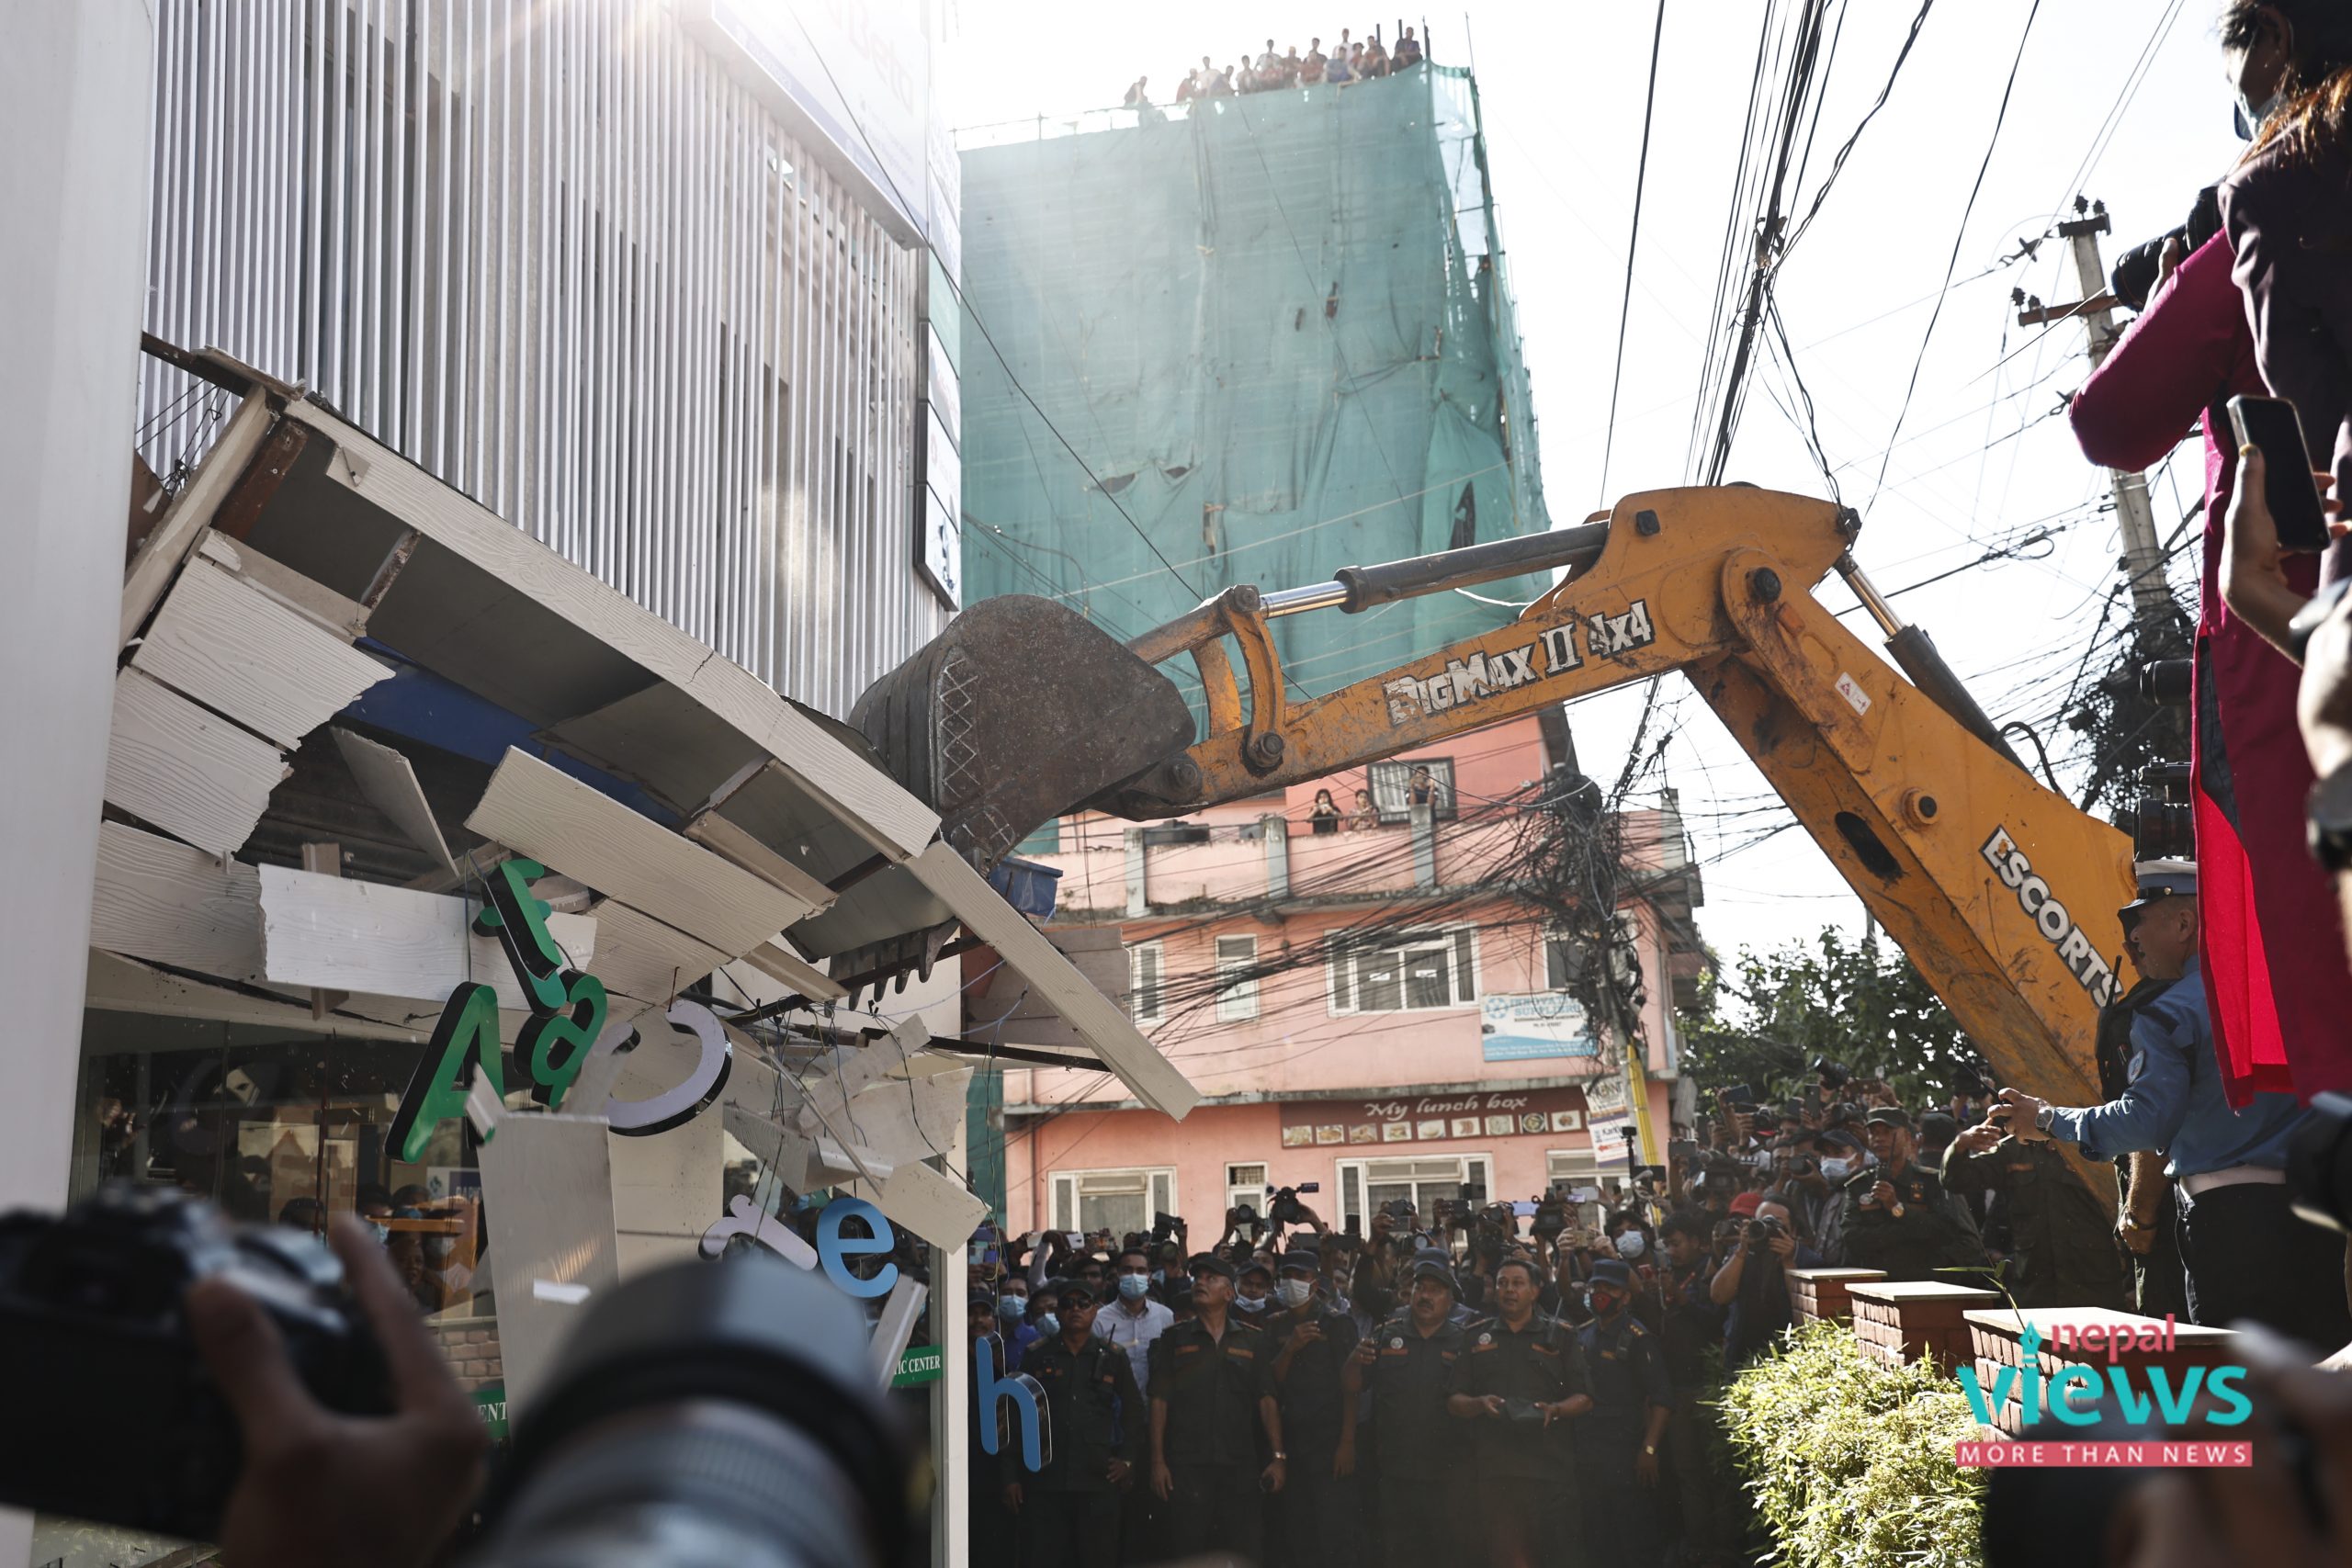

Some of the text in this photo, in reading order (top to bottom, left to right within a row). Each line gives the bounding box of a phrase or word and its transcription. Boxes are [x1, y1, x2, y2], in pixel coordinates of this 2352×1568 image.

[1980, 825, 2123, 1008] ESCORTS
[1364, 1094, 1528, 1121] My lunch box
[909, 1355, 941, 1372] CENTER
